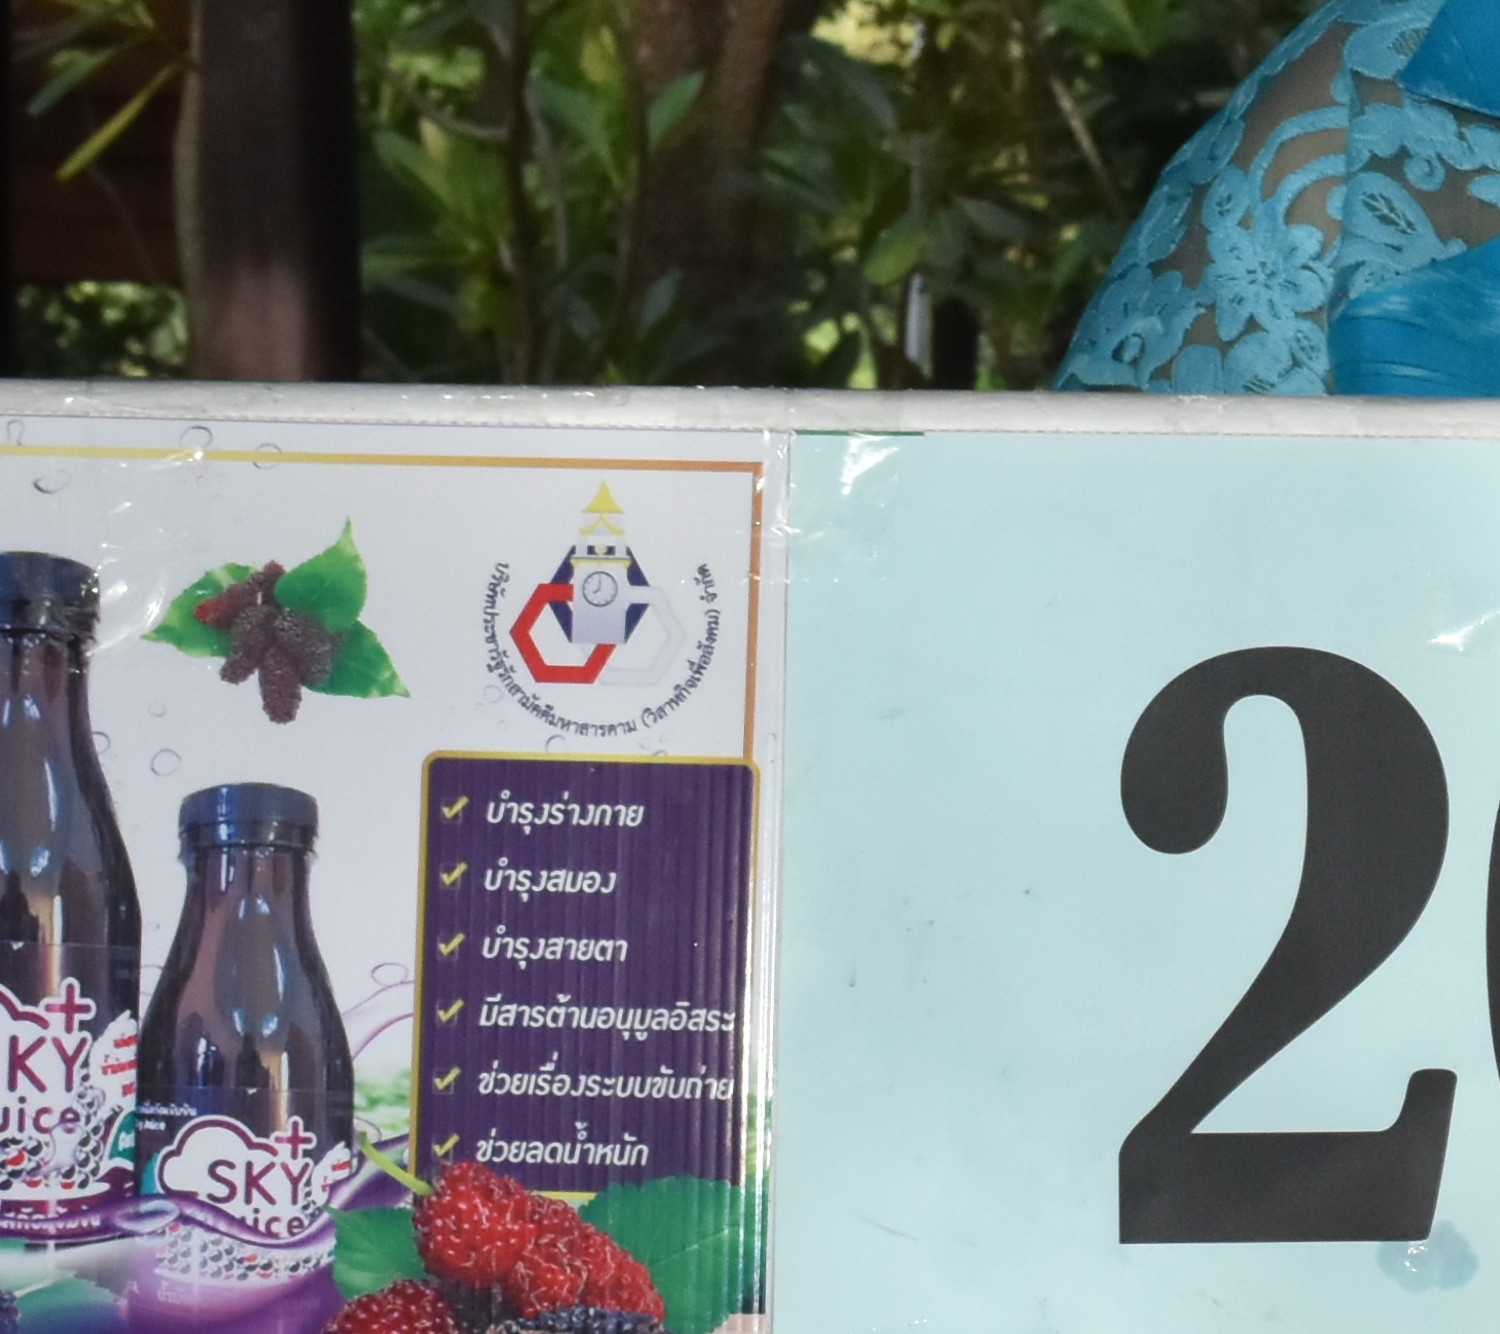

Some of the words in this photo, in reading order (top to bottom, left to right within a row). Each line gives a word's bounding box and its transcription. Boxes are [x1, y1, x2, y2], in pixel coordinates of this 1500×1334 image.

[485, 789, 645, 835] บำรุงร่างกาย
[483, 856, 618, 902] บำรุงสมอง
[481, 923, 629, 970] บำรุงสายตา
[478, 992, 737, 1042] มีสารต้านอนุมูลอิสระ
[477, 1051, 735, 1101] ช่วยเรื่องระบบขับถ่าย
[475, 1121, 650, 1168] ช่วยลดน้ำหนัก
